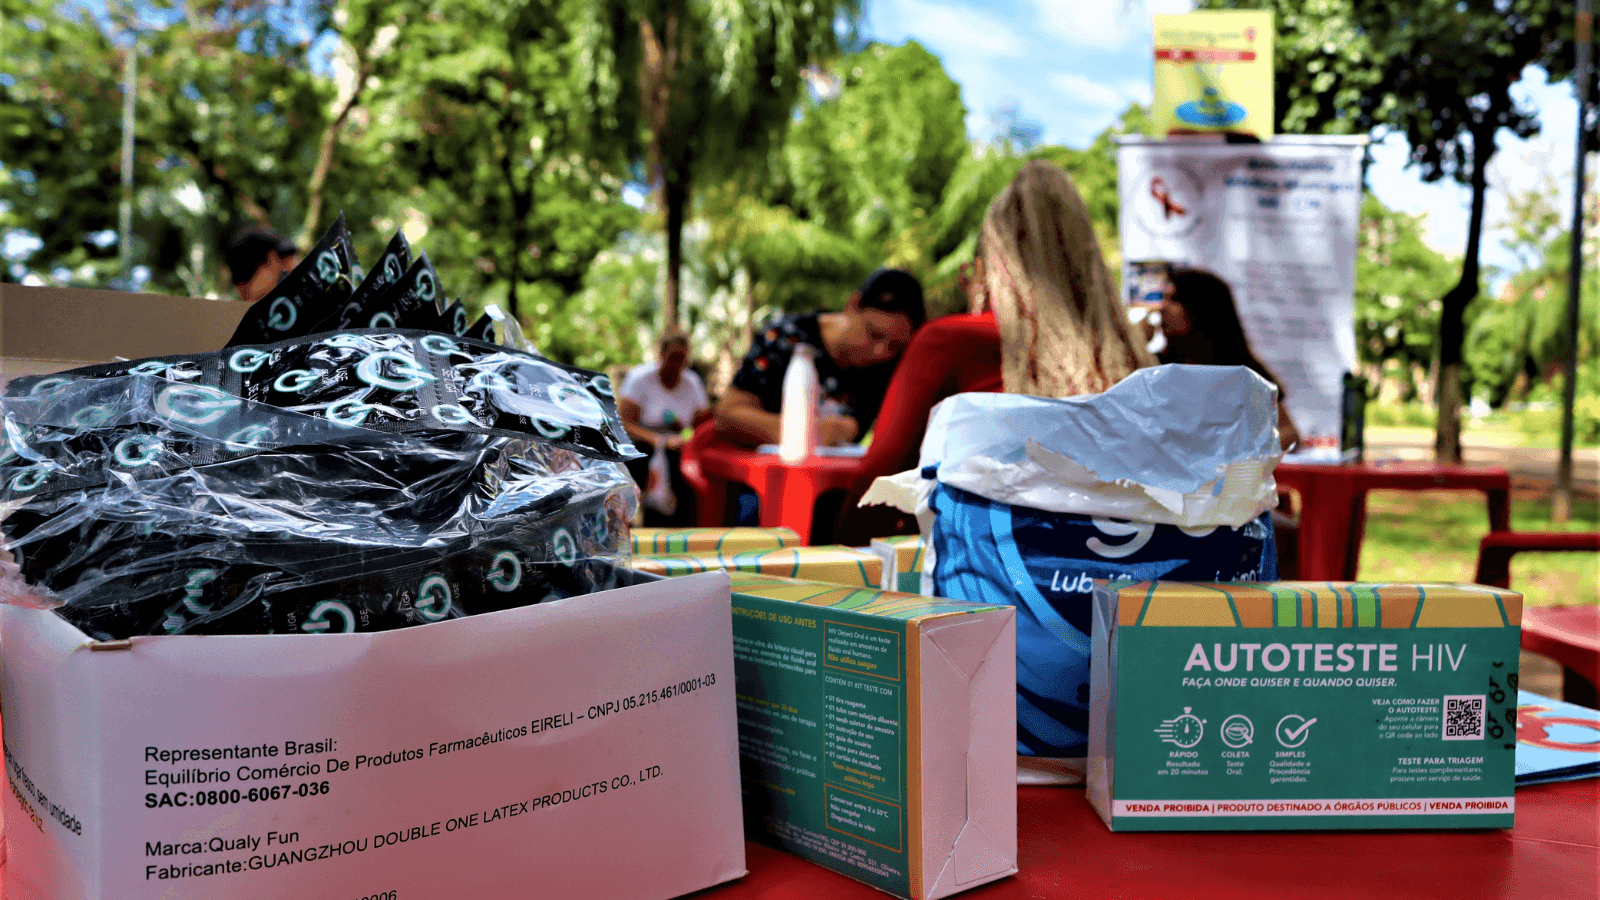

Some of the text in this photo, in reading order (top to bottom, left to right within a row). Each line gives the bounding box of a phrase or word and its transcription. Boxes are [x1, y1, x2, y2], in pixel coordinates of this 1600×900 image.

[360, 609, 370, 627] USE
[779, 615, 792, 624] USO
[795, 617, 817, 629] ANTES
[854, 632, 865, 640] Oral
[1183, 642, 1467, 673] AUTOTESTE HIV
[805, 668, 816, 676] para
[864, 683, 878, 693] TESTE
[880, 688, 893, 696] COM
[1182, 677, 1397, 689] FAÇA ONDE QUISER E QUANDO QUISER.
[1385, 715, 1408, 723] Aponte
[145, 768, 231, 788] Equilíbrio
[236, 762, 320, 781] Comércio
[326, 759, 350, 773] De
[355, 748, 424, 769] Produtos
[429, 726, 528, 757] Farmacêuticos
[531, 712, 574, 734] EIRELI
[588, 700, 620, 720] CNPJ
[622, 673, 716, 711] 05.215.461/0001-03
[145, 738, 338, 765] Representante Brasil:
[1170, 750, 1198, 758] RÁPIDO
[1270, 760, 1304, 768] Qualidade
[1226, 768, 1243, 776] Oral.
[1270, 776, 1308, 784] garantidas.
[145, 781, 330, 808] SAC:0800-6067-036
[1125, 804, 1160, 812] VENDA
[1164, 804, 1210, 812] PROIBIDA
[1217, 803, 1264, 812] PRODUTO
[1267, 803, 1322, 812] DESTINADO
[1334, 801, 1374, 811] ÓRGÃOS
[1377, 801, 1422, 811] PÚBLICOS
[1430, 802, 1463, 810] VENDA
[1465, 801, 1509, 810] PROIBIDA
[49, 801, 82, 836] umidade
[146, 764, 664, 881] Fabricante:GUANGZHOU DOUBLE ONE LATEX PRODUCTS CO., LTD.
[145, 831, 300, 857] Marca:Qualy Fun
